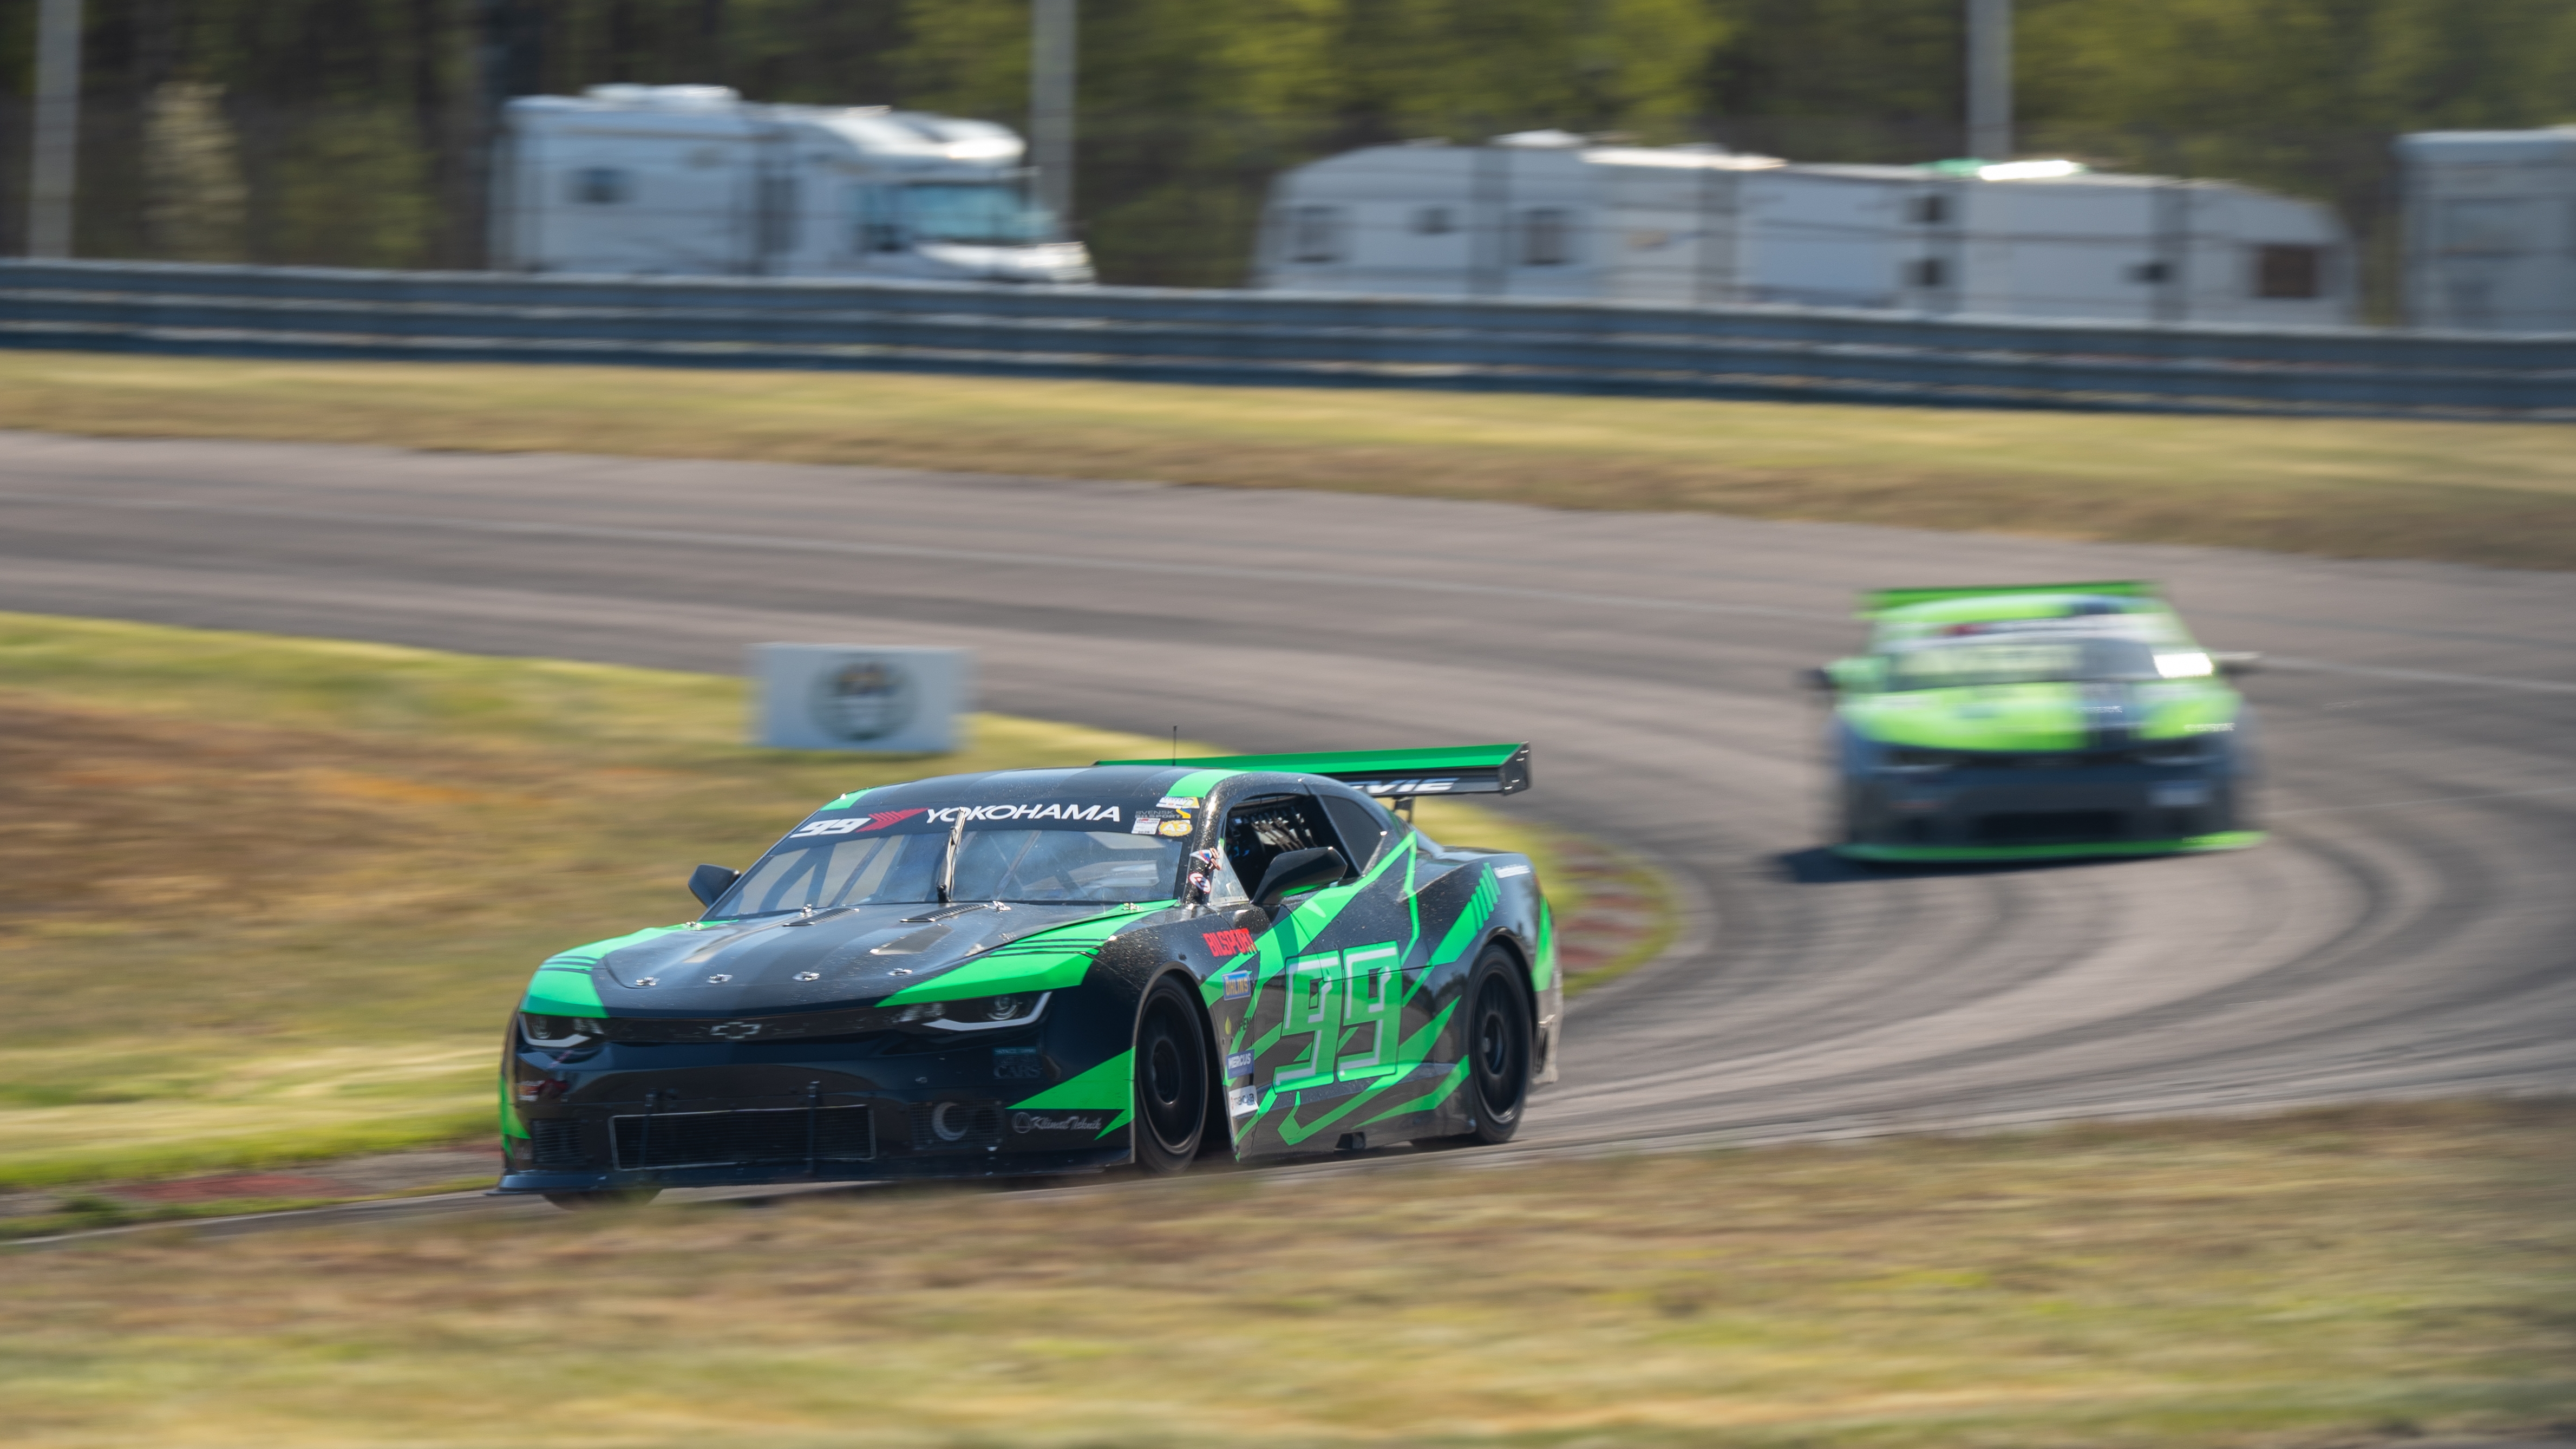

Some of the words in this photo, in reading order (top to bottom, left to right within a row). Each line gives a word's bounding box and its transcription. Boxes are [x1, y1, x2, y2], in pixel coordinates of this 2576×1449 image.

[926, 804, 1121, 823] YOKOHAMA
[789, 818, 872, 838] 99
[1162, 823, 1188, 832] A3
[1202, 928, 1257, 957] BILSPORT
[1273, 940, 1402, 1094] 99
